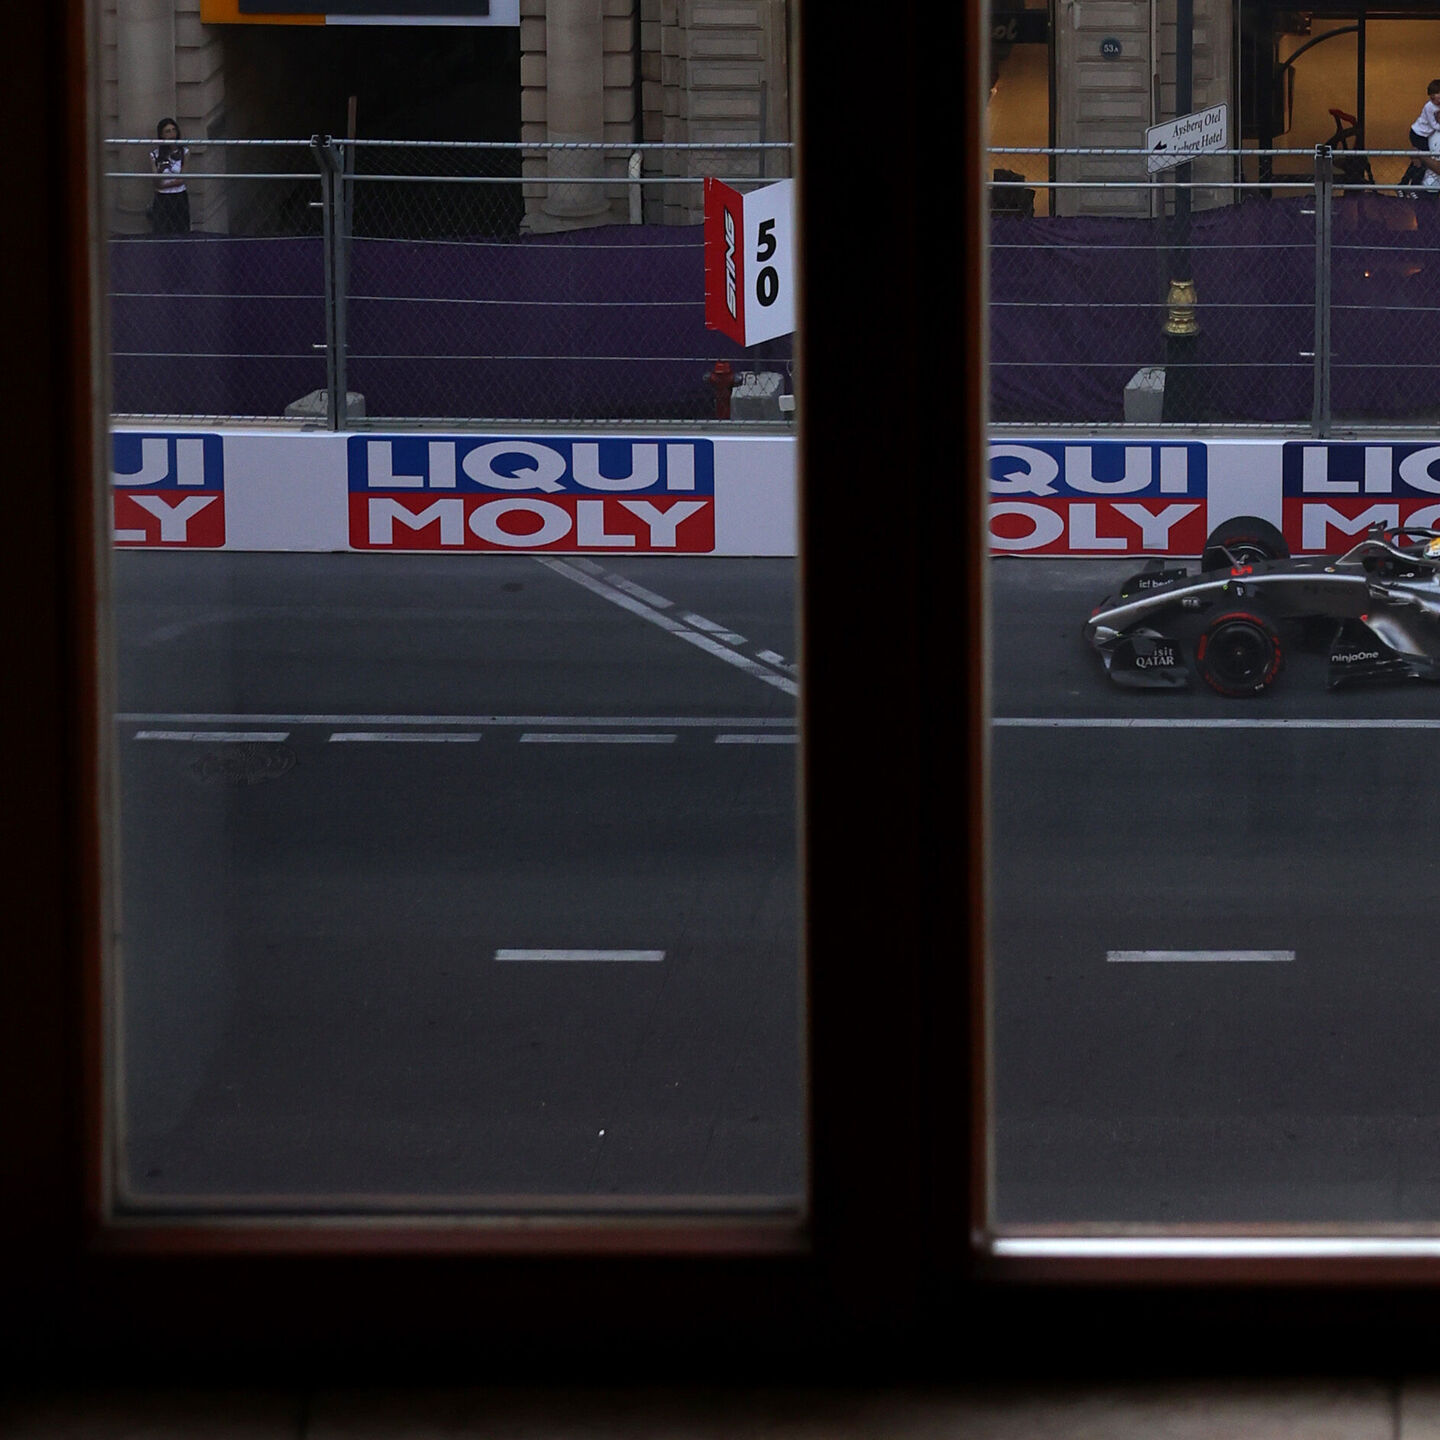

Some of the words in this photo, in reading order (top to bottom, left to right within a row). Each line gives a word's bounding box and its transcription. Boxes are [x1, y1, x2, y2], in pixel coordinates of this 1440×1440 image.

[1205, 109, 1221, 126] Otel
[1202, 129, 1223, 148] Hotel
[724, 206, 737, 321] STING
[368, 439, 695, 493] LIQUI
[368, 497, 707, 547] MOLY
[1136, 656, 1175, 669] QATAR
[1332, 651, 1379, 663] ninjaOne
